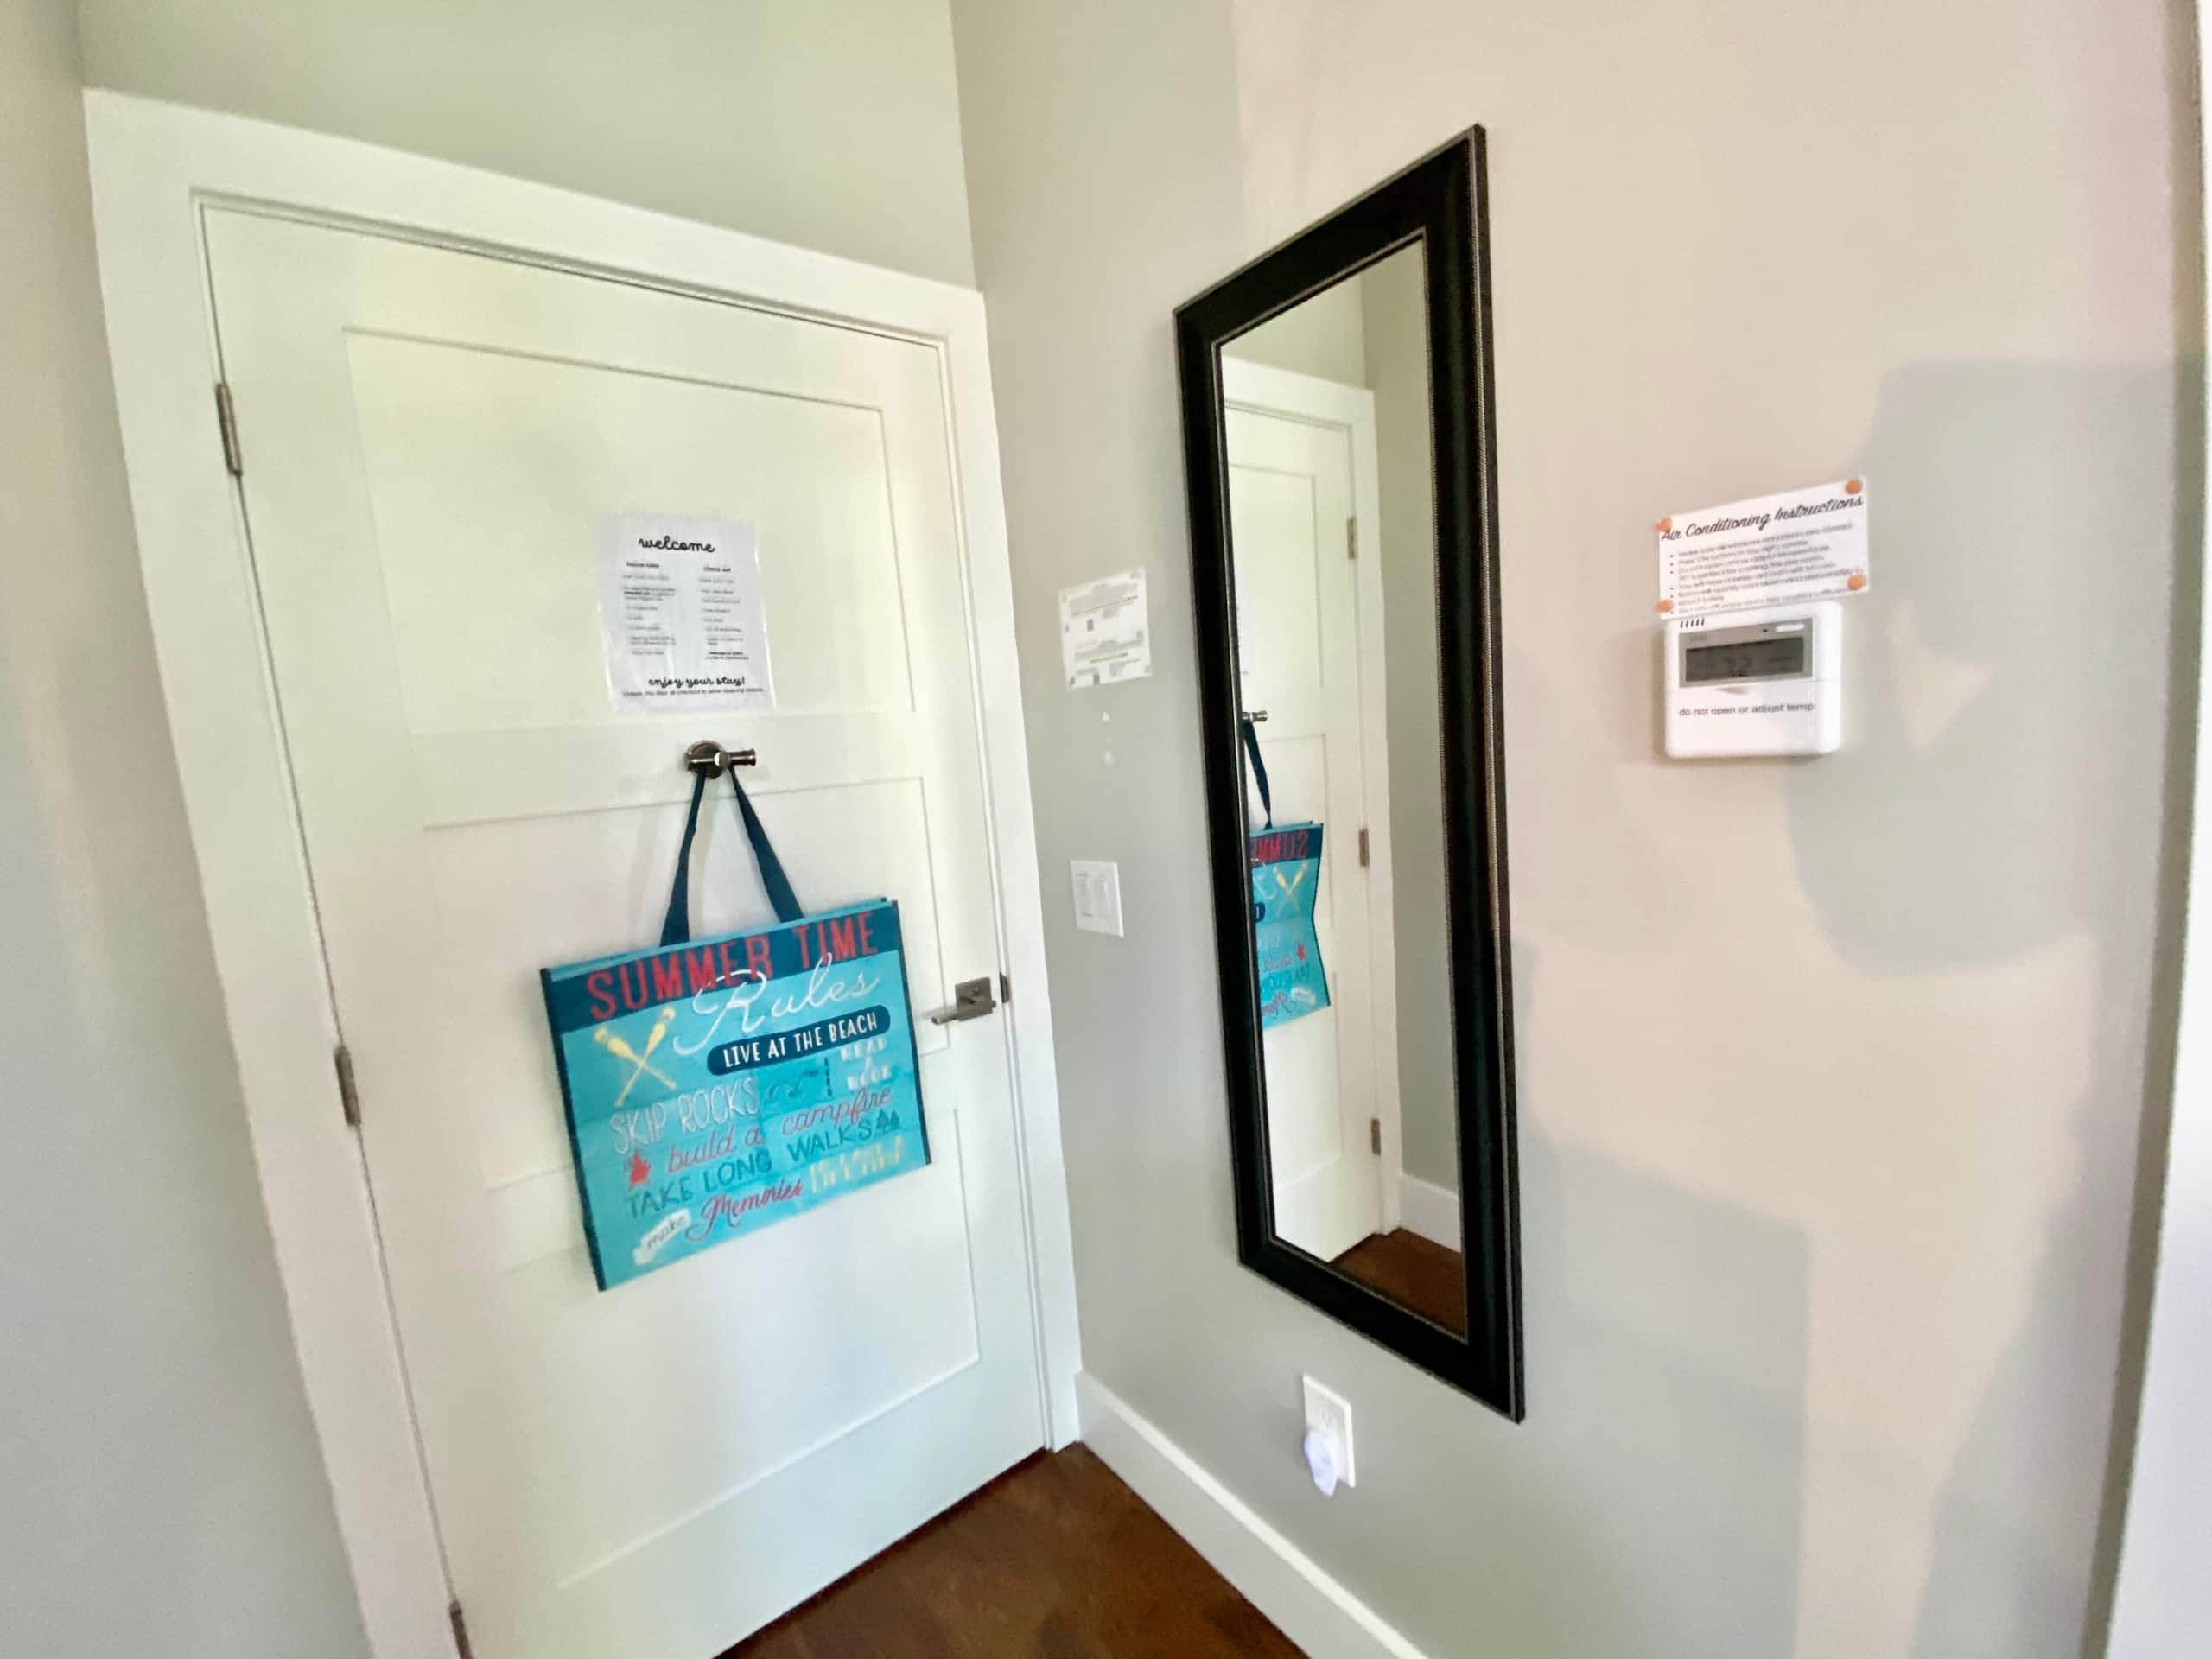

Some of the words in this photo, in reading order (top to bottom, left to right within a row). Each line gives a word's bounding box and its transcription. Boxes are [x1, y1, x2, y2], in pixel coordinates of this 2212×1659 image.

[638, 535, 715, 553] welcome
[1685, 513, 1770, 537] Conditioning
[1774, 496, 1863, 520] Instructions
[648, 677, 684, 689] enjoy
[685, 677, 715, 689] your
[715, 676, 746, 687] stay!
[1679, 708, 1691, 716] do
[1711, 707, 1736, 716] open
[1751, 703, 1784, 715] adjust
[1786, 702, 1815, 713] temp
[586, 933, 772, 1020] SUMMER
[791, 910, 878, 969] TIME
[673, 952, 880, 1055] Rules
[722, 1041, 760, 1068] LIVE
[767, 1037, 787, 1059] AT
[793, 1027, 823, 1052] THE
[829, 1011, 878, 1043] BEACH
[608, 1102, 667, 1154] SKIP
[677, 1077, 760, 1134] ROCKS
[667, 1123, 737, 1173] build
[744, 1126, 765, 1146] a
[781, 1087, 893, 1136] campfire
[624, 1176, 694, 1219] TAKE
[702, 1148, 773, 1192] LONG
[785, 1119, 874, 1162] WALKS
[684, 1179, 804, 1242] Memories
